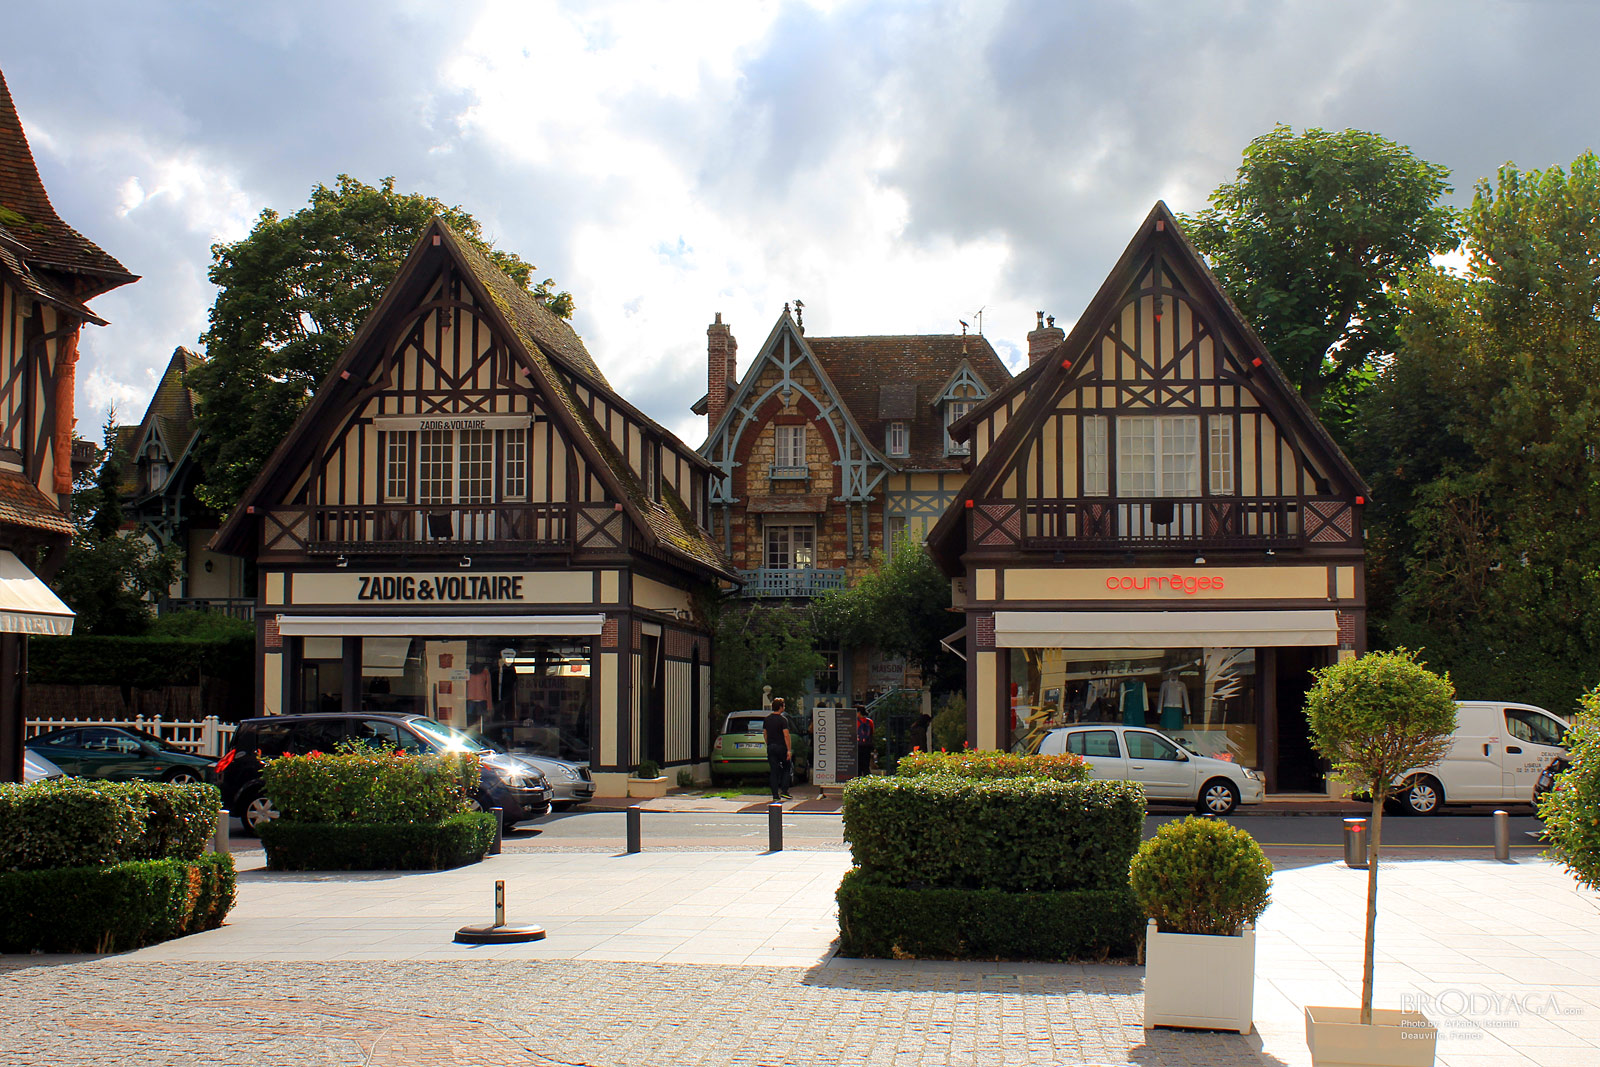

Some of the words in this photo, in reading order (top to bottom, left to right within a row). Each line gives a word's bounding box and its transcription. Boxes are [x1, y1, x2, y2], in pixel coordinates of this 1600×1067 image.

[420, 420, 485, 430] ZADIG&VOLTAIRE
[358, 576, 523, 600] ZADIG&VOLTAIRE
[1106, 574, 1224, 594] courrèges
[872, 664, 903, 673] MAISON
[815, 710, 827, 756] maison
[816, 760, 827, 772] la
